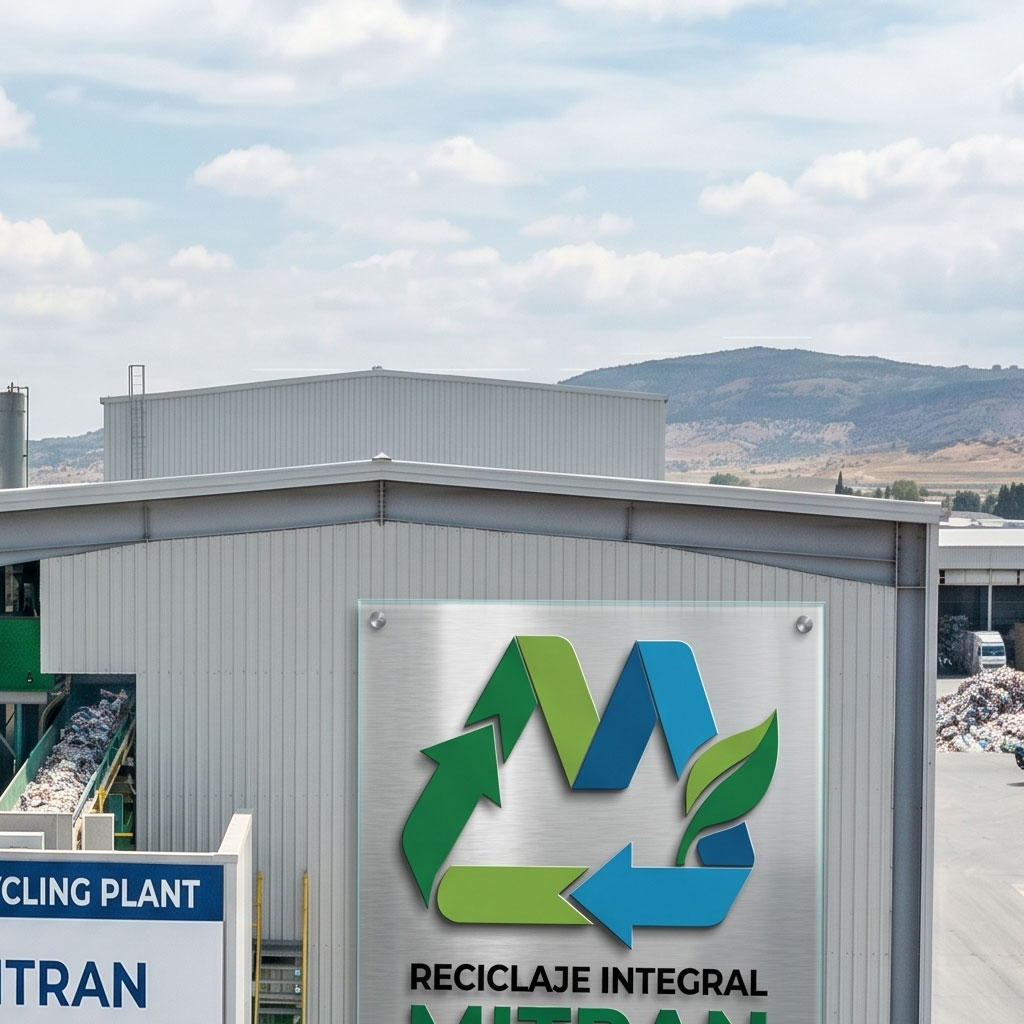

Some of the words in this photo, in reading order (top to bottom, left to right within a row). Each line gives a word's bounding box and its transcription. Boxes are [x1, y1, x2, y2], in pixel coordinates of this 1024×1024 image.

[101, 879, 201, 908] PLANT
[410, 964, 590, 993] RECICLAJE
[601, 967, 768, 996] INTEGRAL
